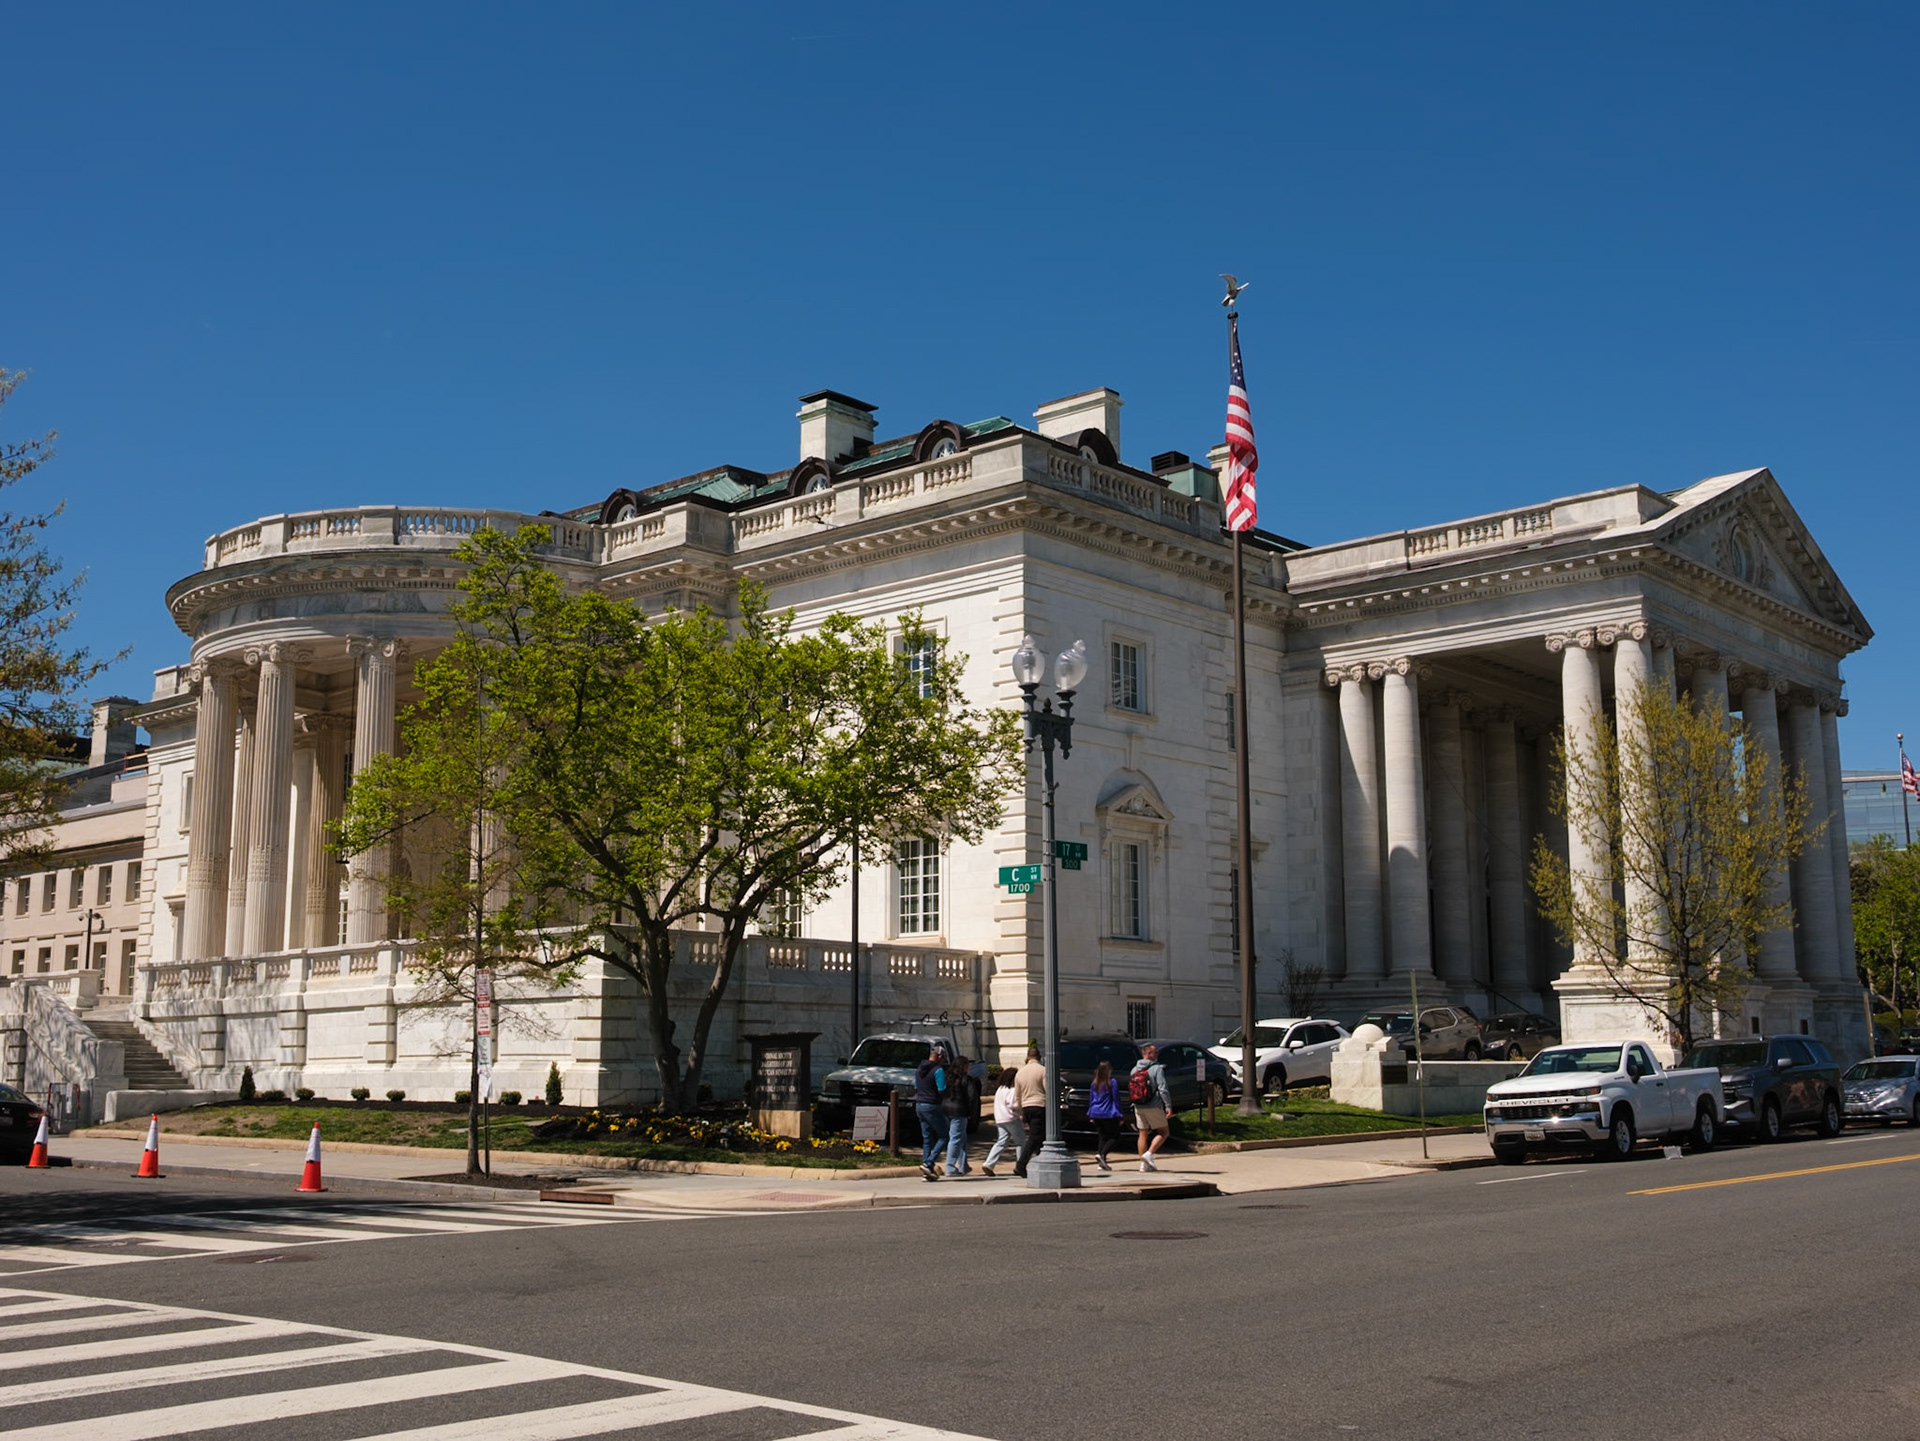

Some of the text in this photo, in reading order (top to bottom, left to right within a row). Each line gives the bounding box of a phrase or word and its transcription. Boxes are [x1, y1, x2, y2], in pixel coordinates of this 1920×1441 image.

[1062, 844, 1070, 857] 17
[1065, 860, 1078, 868] 300
[1011, 868, 1019, 881] C
[1010, 883, 1030, 893] 1700
[1499, 1098, 1571, 1106] CHEVROLET
